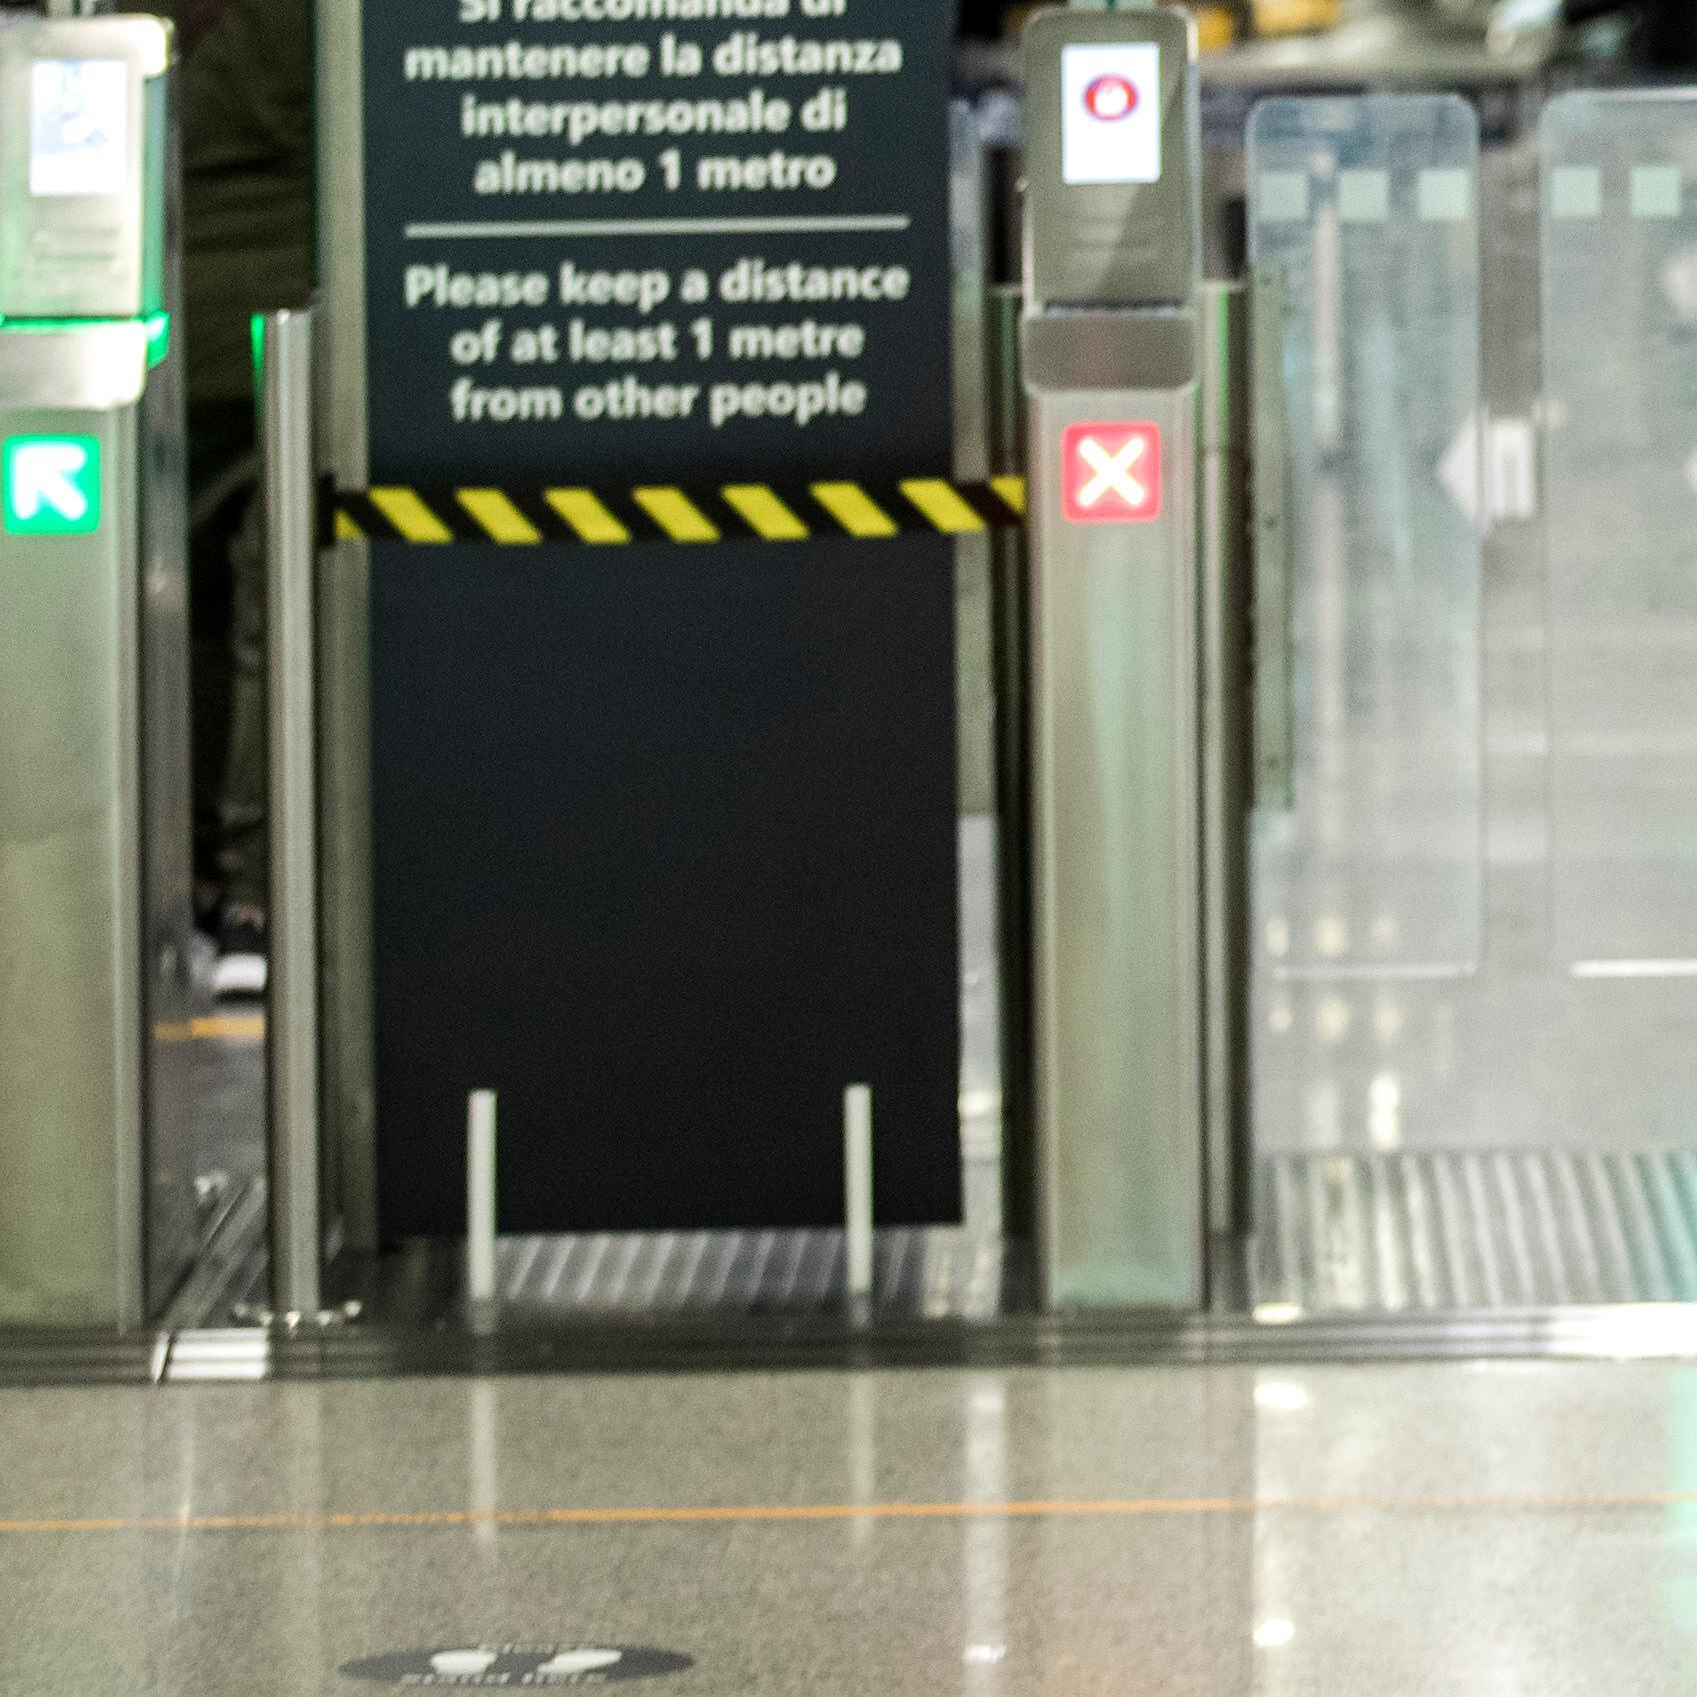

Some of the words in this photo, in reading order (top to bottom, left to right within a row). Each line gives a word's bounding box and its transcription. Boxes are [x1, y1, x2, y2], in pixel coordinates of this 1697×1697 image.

[405, 41, 651, 79] mantenere
[660, 32, 702, 75] la
[713, 32, 902, 75] distanza
[462, 93, 791, 145] interpersonale
[801, 88, 846, 130] di
[474, 150, 645, 193] almeno
[660, 148, 680, 189] 1
[697, 150, 836, 189] metro
[405, 263, 549, 306] Please
[560, 262, 670, 313] keep
[681, 270, 709, 302] a
[719, 258, 909, 301] distance
[451, 321, 501, 363] of
[511, 325, 557, 362] at
[569, 320, 676, 361] least
[692, 318, 712, 358] 1
[729, 321, 864, 358] metre
[451, 377, 564, 420] from
[574, 376, 699, 418] other
[710, 372, 866, 426] people
